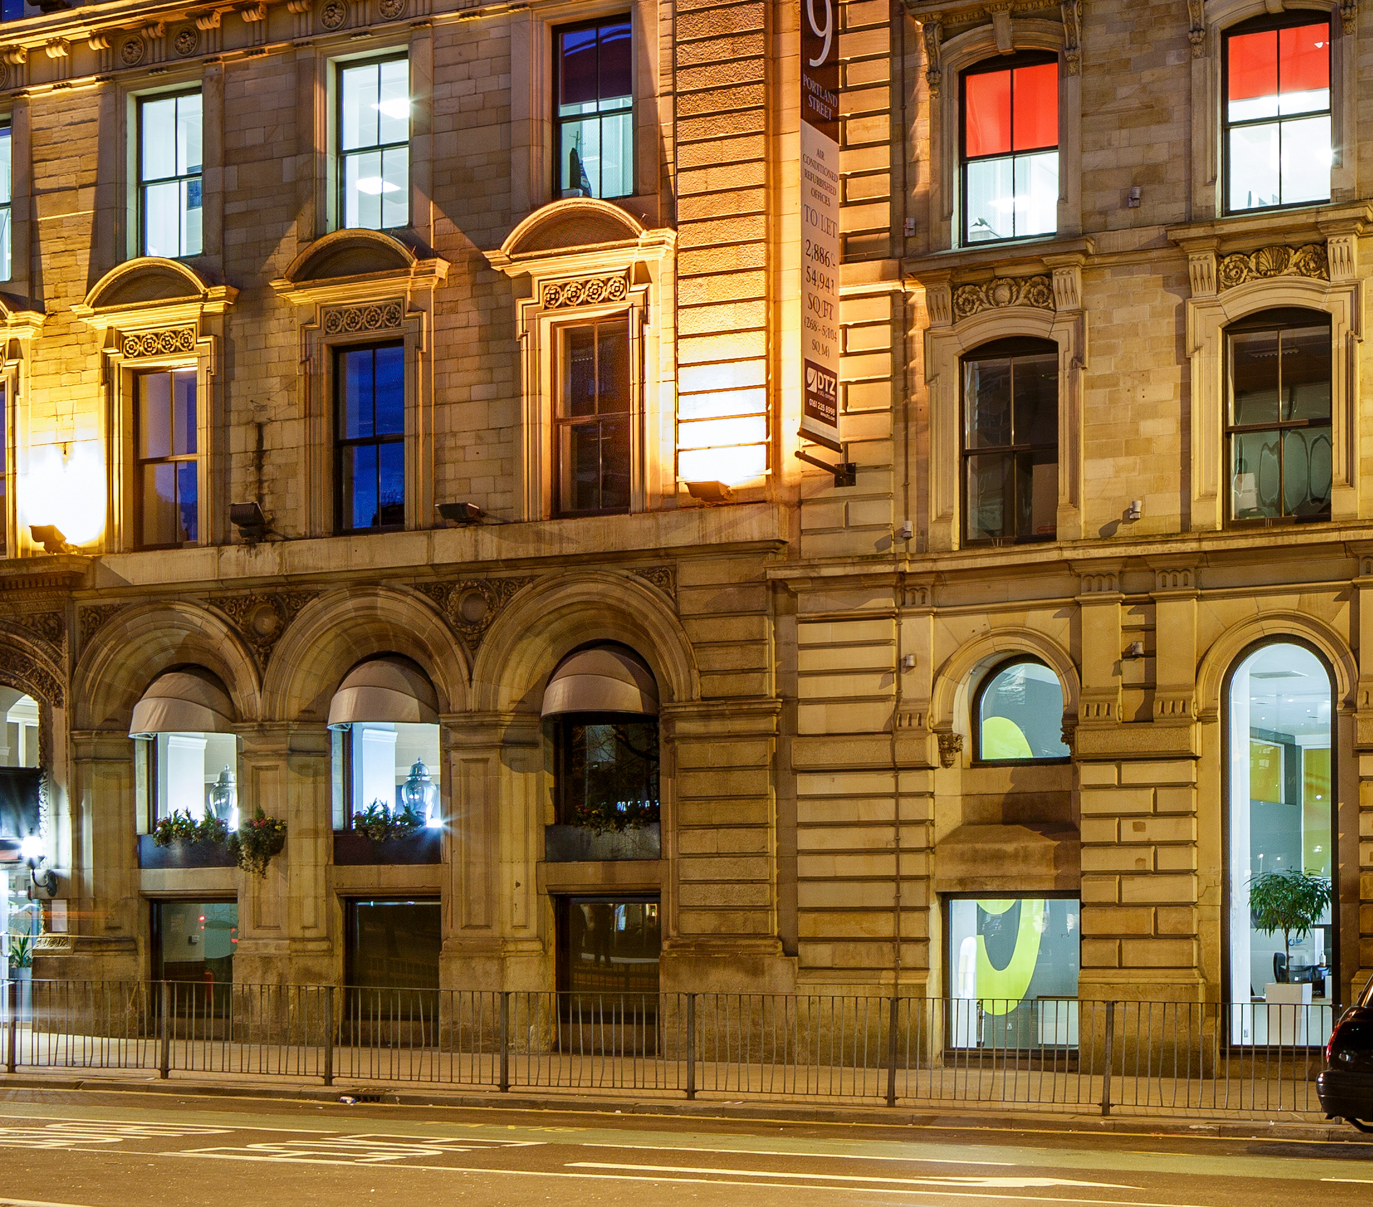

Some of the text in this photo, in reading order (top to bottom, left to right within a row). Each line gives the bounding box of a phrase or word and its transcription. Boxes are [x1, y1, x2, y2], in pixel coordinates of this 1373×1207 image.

[803, 73, 838, 108] PORTLAND
[808, 95, 833, 121] STREET
[804, 168, 837, 196] REFURBISHED
[804, 203, 837, 239] TO LET
[807, 292, 834, 321] SQ FT
[818, 371, 836, 396] DTZ
